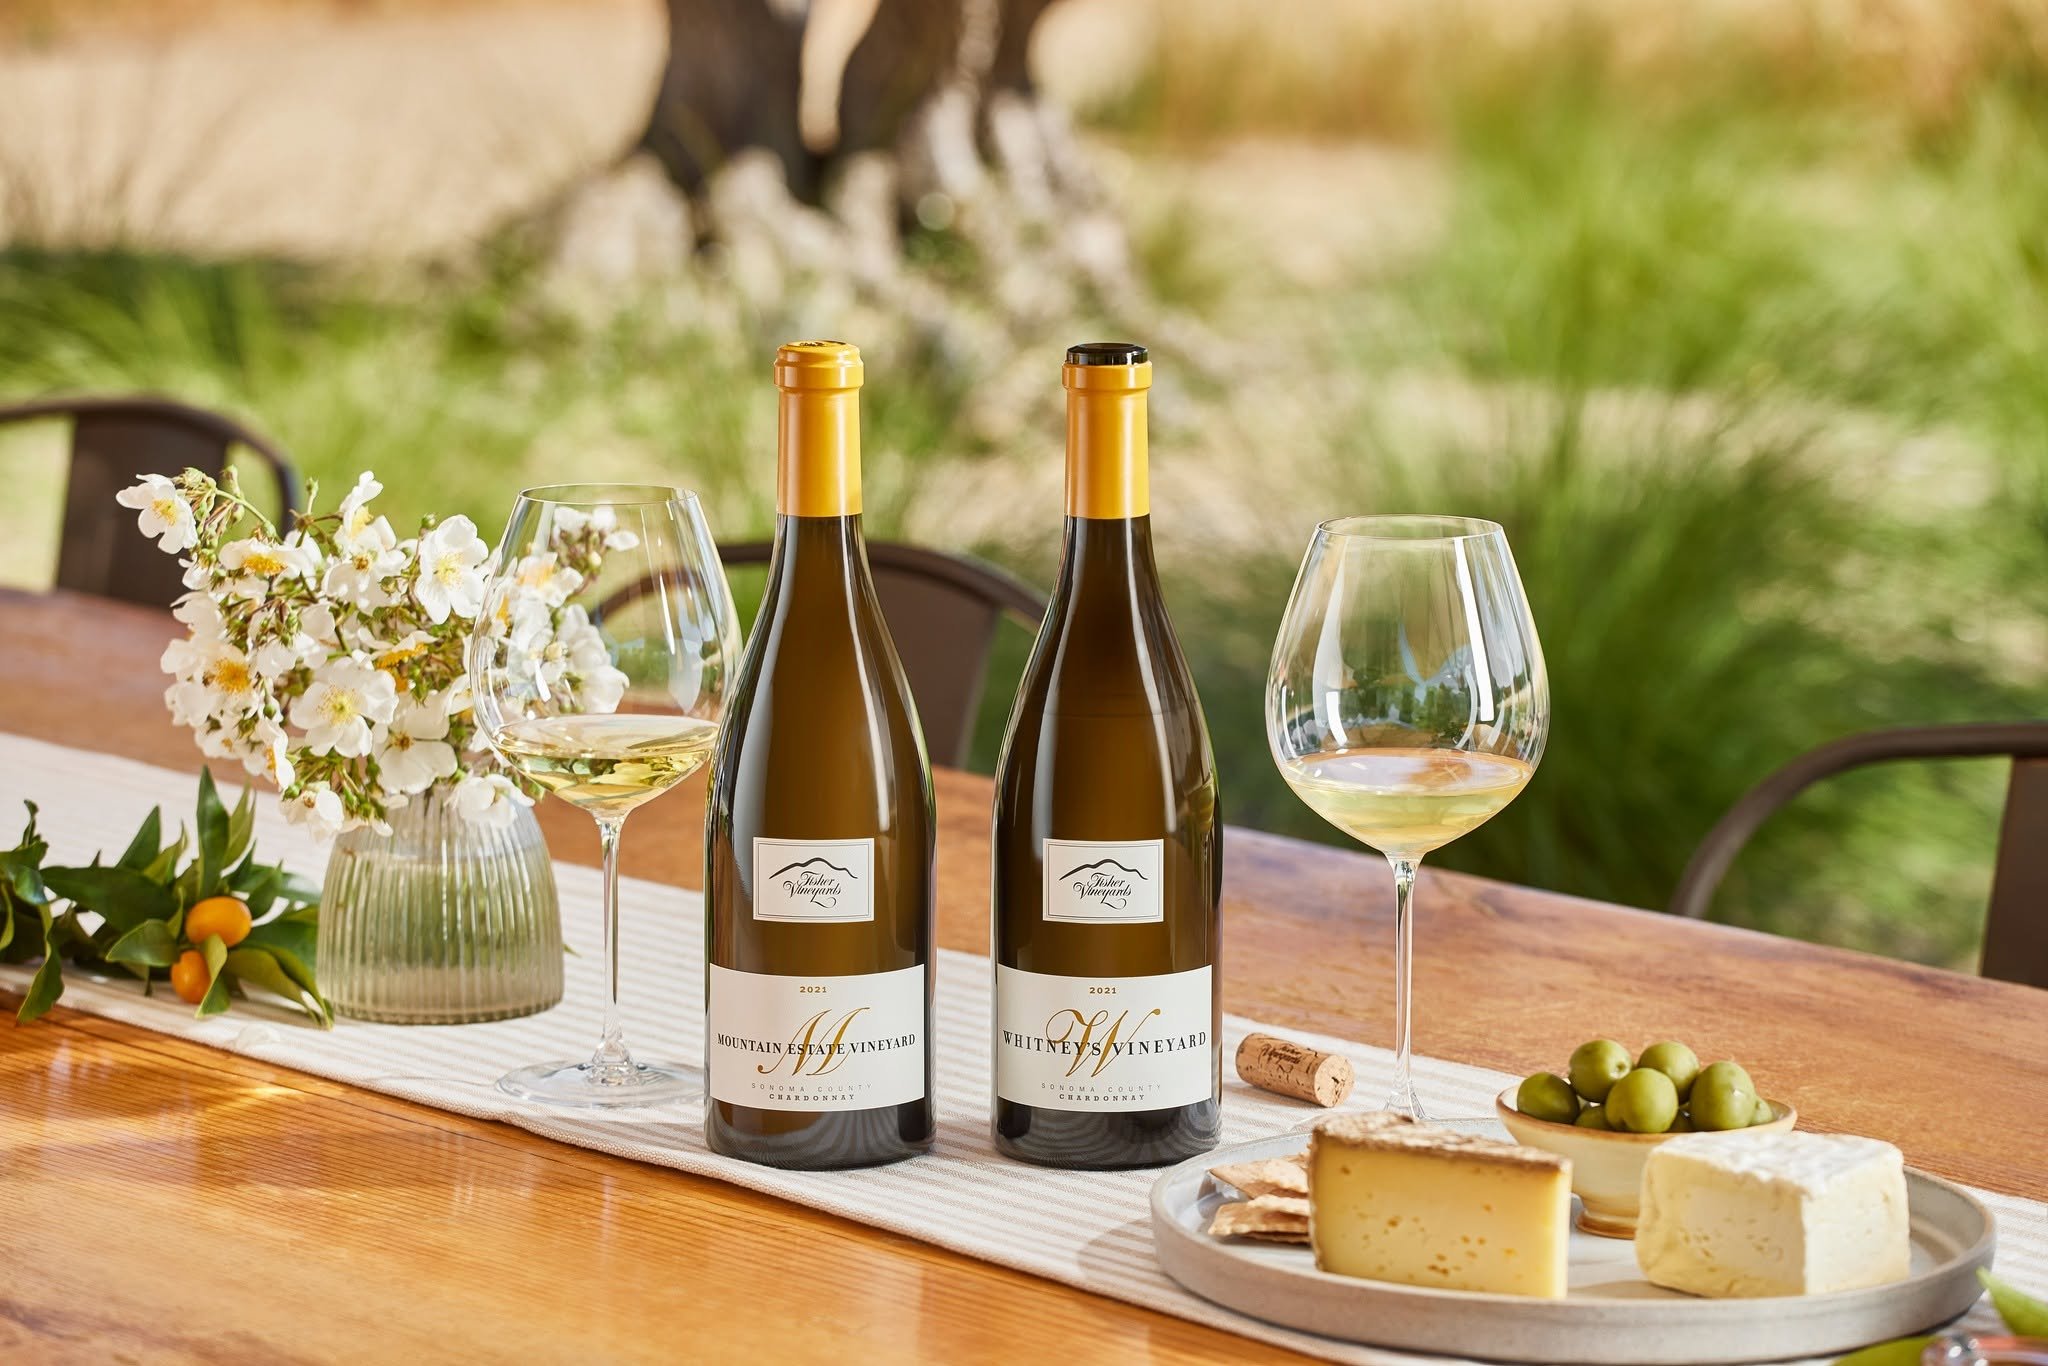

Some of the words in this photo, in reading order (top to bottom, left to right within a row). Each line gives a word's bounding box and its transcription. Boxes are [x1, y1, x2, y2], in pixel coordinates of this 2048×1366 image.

[796, 871, 835, 887] Fisher
[1086, 872, 1126, 888] Fisher
[783, 880, 842, 909] Vineyards
[1073, 881, 1132, 910] Vineyards
[799, 986, 828, 994] 2021
[1089, 986, 1117, 995] 2021
[717, 1033, 782, 1054] MOUNTAIN
[788, 1043, 846, 1056] ESTATE
[850, 1033, 916, 1054] VINEYARD
[1045, 1008, 1161, 1078] W
[1111, 1031, 1207, 1056] VINEYARD
[751, 1082, 805, 1092] SONOMA
[817, 1083, 872, 1092] COUNTY
[1041, 1082, 1095, 1092] SONOMA
[1107, 1084, 1161, 1092] COUNTY
[769, 1093, 855, 1101] CHARDONNAY
[1059, 1093, 1145, 1101] CHARDONNAY
